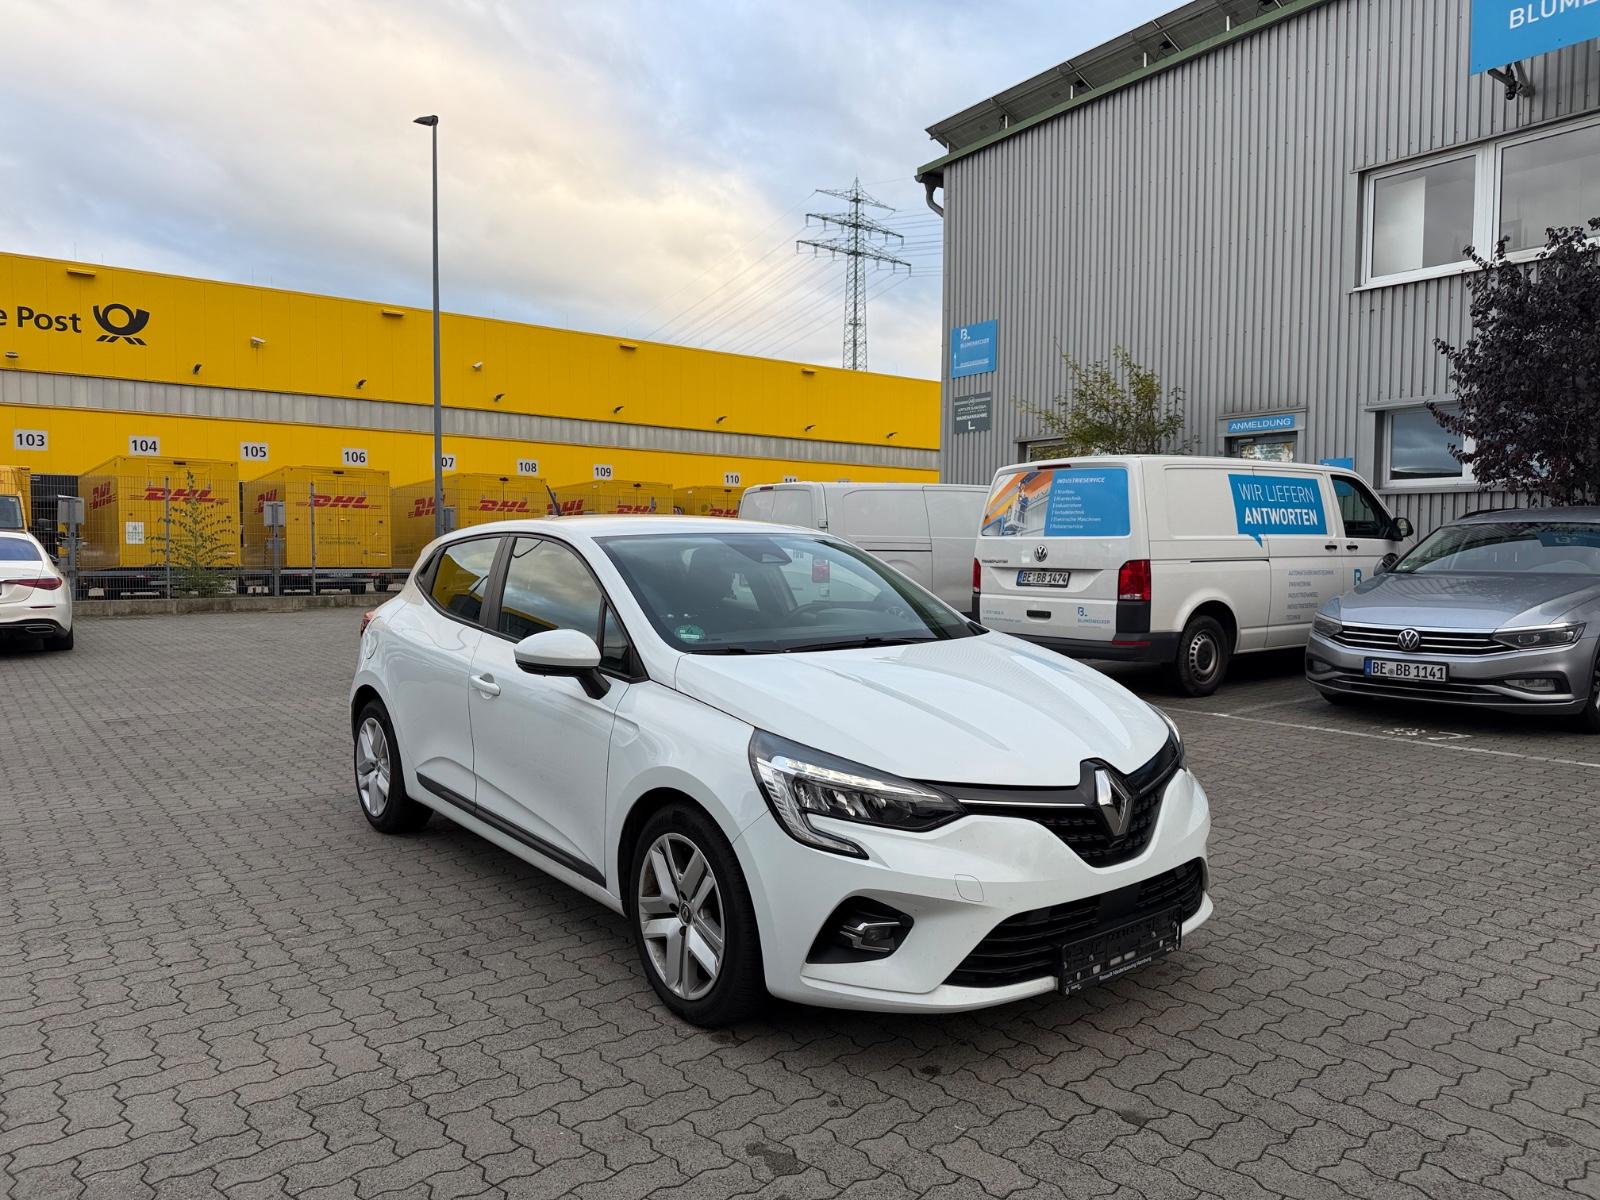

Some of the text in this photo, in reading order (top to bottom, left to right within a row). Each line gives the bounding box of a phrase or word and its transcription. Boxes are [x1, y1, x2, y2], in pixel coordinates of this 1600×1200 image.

[17, 306, 82, 334] Post
[1231, 417, 1291, 431] ANMELDUNG
[16, 433, 45, 447] 103
[131, 439, 158, 453] 104
[243, 446, 267, 458] 105
[344, 451, 366, 463] 106
[441, 457, 454, 468] 07
[519, 462, 537, 472] 108
[595, 467, 612, 477] 109
[725, 474, 740, 484] 110
[144, 487, 218, 503] DHL
[1238, 483, 1315, 504] WIR LIEFERN
[308, 494, 370, 509] DHL
[479, 500, 530, 513] DHL
[1244, 507, 1318, 526] ANTWORTEN
[1022, 572, 1067, 584] BE BB 1474
[1372, 661, 1445, 680] BE BB 1141
